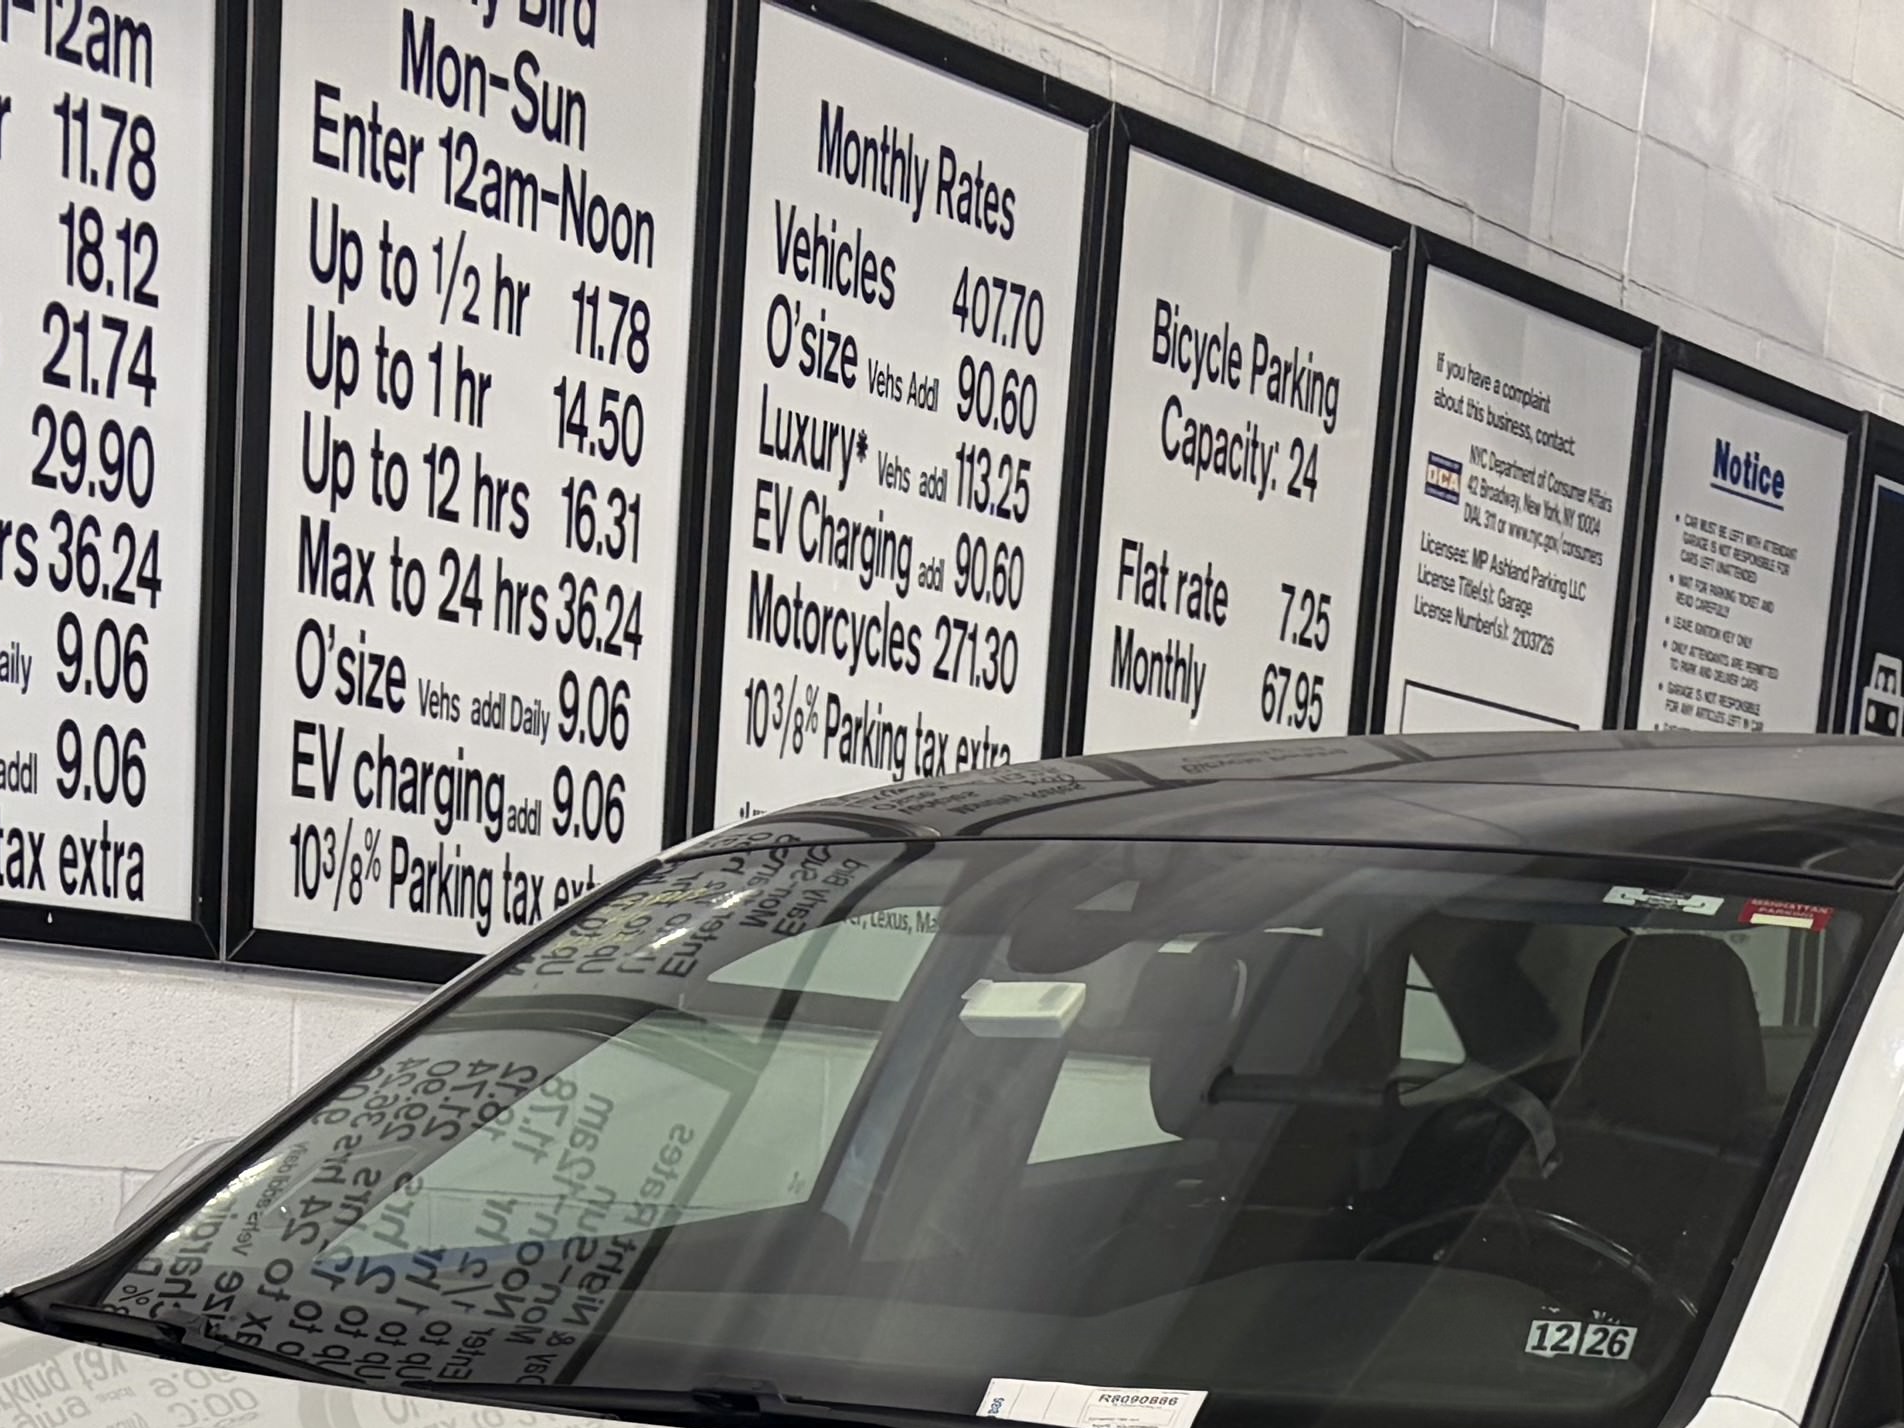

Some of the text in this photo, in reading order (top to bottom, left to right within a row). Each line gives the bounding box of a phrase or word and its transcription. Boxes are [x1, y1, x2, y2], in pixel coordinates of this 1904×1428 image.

[54, 92, 156, 201] 11.78
[313, 80, 424, 193] Enter
[818, 100, 1015, 240] Monthly Rates
[60, 202, 158, 308] 18.12
[310, 198, 362, 304] Up
[380, 220, 417, 306] to
[494, 254, 530, 336] hr
[572, 281, 650, 374] 11.78
[776, 200, 1044, 356] Vehicles 407.70
[43, 302, 156, 407] 21.74
[306, 305, 644, 466] Up to 1 hr 14.50
[869, 358, 902, 402] Vehs
[907, 372, 938, 411] Addl
[958, 356, 1036, 440] 90.60
[1152, 298, 1339, 434] Bicycle Parking
[1434, 387, 1464, 415] about
[32, 404, 154, 508] 29.90
[303, 410, 640, 562] Up to 12 hrs 16.31
[879, 451, 910, 492] Vehs
[920, 470, 946, 501] addl
[956, 442, 1030, 522] 113.25
[1162, 395, 1318, 502] Capacity: 24
[1713, 438, 1785, 499] Notice
[49, 510, 162, 608] 36.24
[298, 516, 642, 660] Max to 24 hrs 36.24
[754, 478, 1024, 610] EV Charging addl 90.60
[1118, 538, 1330, 651] Flat rate 7.25
[1417, 562, 1455, 593] License
[1497, 587, 1533, 619] Garage
[1472, 547, 1489, 570] MP
[1489, 553, 1530, 584] Ashland
[1531, 566, 1567, 600] Parking
[1569, 578, 1587, 601] LLC
[57, 612, 148, 703] 9.06
[748, 570, 1018, 694] Motorcycles 271.30
[1413, 594, 1453, 625] License
[1512, 626, 1555, 656] 2103726
[419, 678, 460, 722] Vehs
[472, 692, 506, 730] addl
[511, 696, 550, 744] Daily
[558, 670, 630, 750] 9.06
[1111, 626, 1324, 732] Monthly 67.95
[57, 719, 146, 808] 9.06
[292, 720, 625, 844] EV charging addl 9.06
[60, 820, 144, 901] extra
[1531, 1322, 1630, 1357] 12 26
